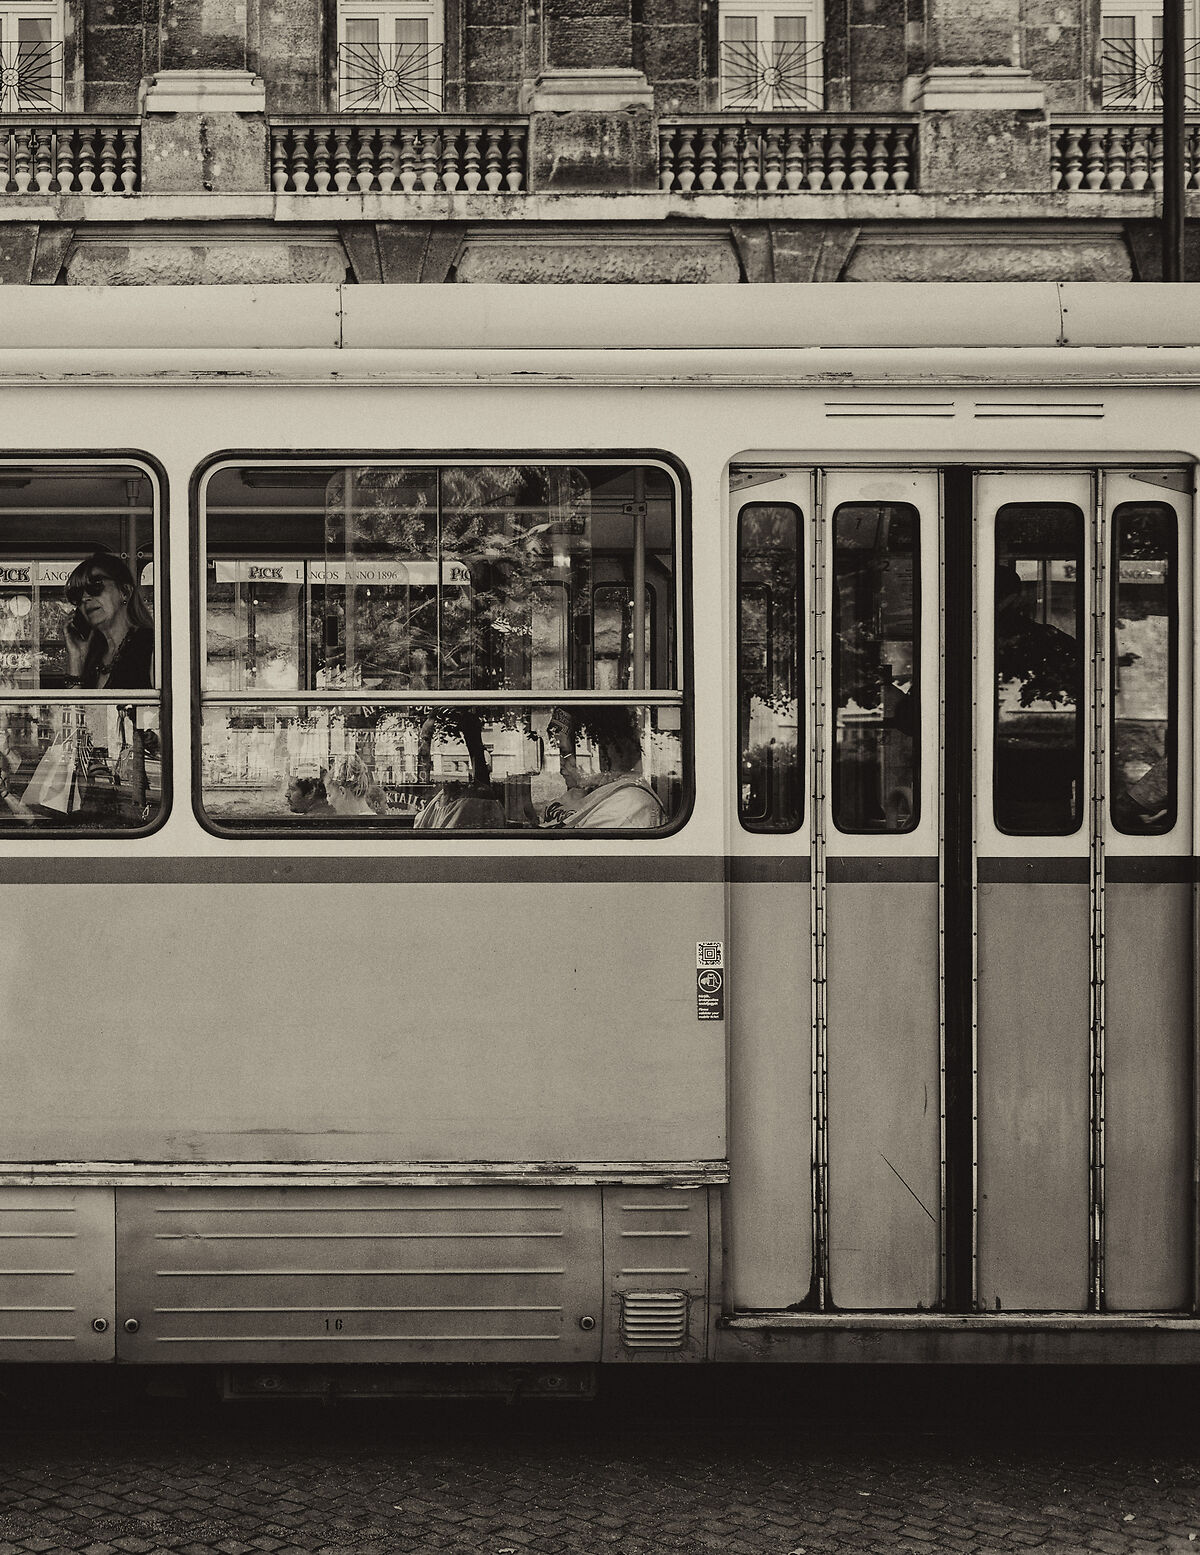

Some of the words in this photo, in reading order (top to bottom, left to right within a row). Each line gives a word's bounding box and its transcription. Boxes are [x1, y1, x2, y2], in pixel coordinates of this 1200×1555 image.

[35, 568, 73, 581] LÁNG
[249, 566, 283, 579] PICK
[295, 569, 339, 580] LNGOS
[377, 571, 398, 580] 1896
[450, 567, 471, 581] PIC
[325, 1319, 343, 1331] 16
